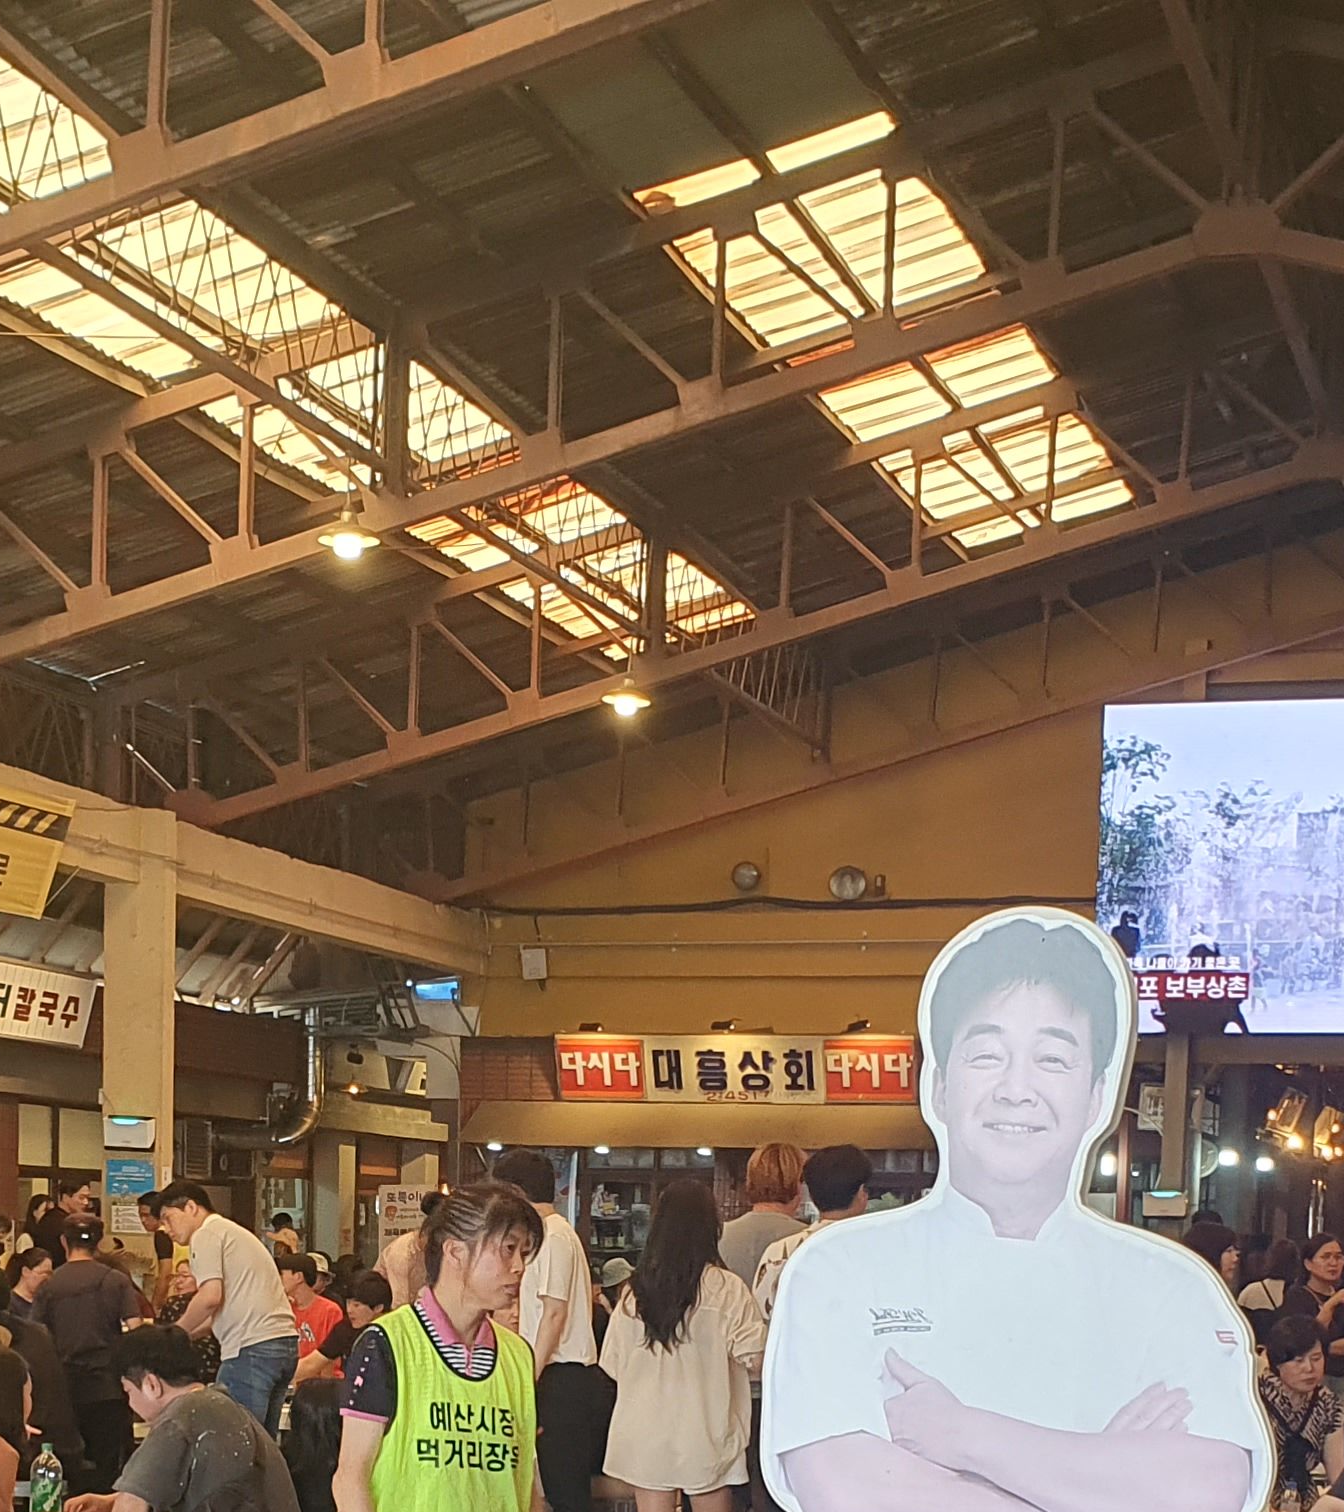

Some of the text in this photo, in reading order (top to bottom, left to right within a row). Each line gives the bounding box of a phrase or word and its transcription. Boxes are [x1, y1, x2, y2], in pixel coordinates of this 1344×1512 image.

[1134, 975, 1248, 999] 포 보부상촌
[560, 1051, 641, 1087] 다시다
[651, 1048, 816, 1092] 대흥상회
[826, 1053, 912, 1089] 다시다
[429, 1401, 515, 1438] 예산시장
